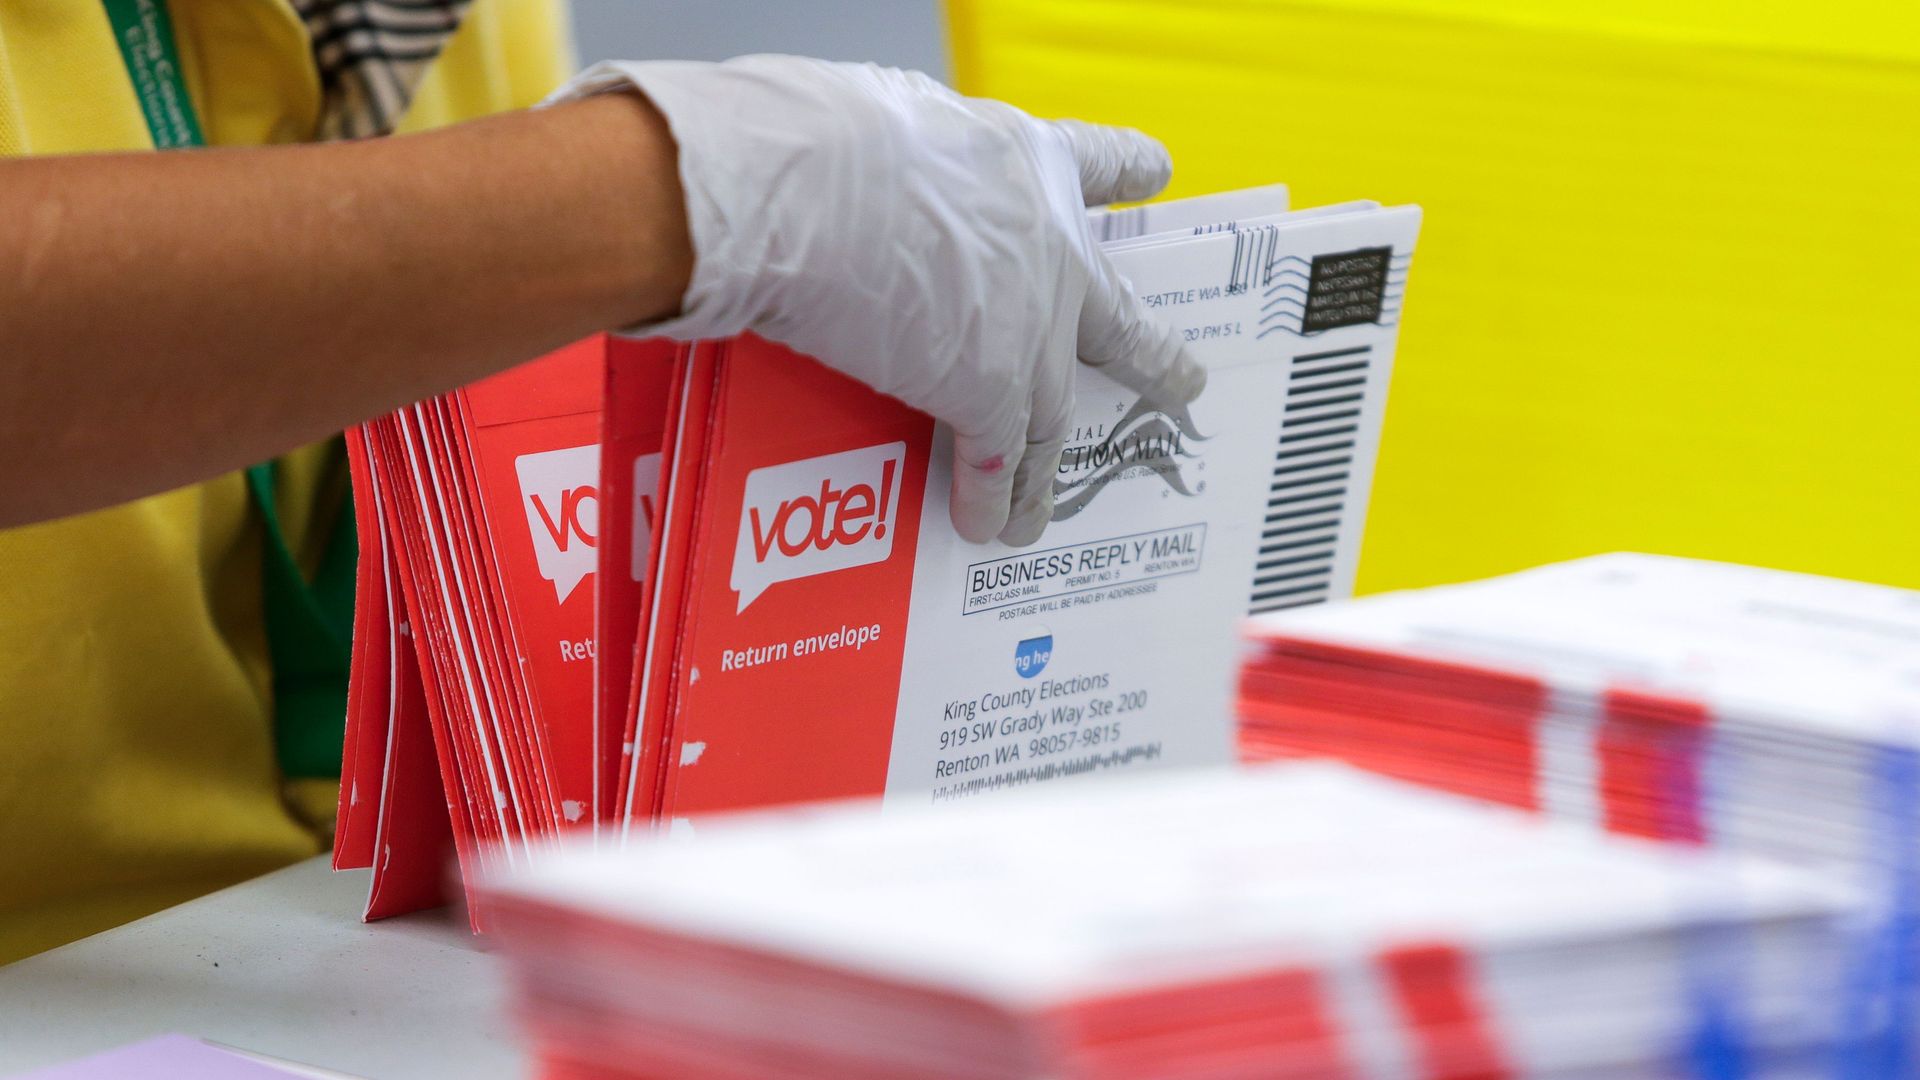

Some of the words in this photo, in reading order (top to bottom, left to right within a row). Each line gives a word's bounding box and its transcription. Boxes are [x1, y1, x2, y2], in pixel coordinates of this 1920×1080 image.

[1141, 289, 1196, 308] EATTLE
[1199, 286, 1220, 300] WA
[1202, 325, 1221, 340] PM
[1223, 323, 1233, 336] 5
[1132, 431, 1184, 462] MAIL
[750, 458, 897, 563] vote!
[970, 588, 1020, 607] FIRST-CLASS
[1022, 584, 1040, 596] MAIL
[1065, 573, 1096, 588] PERMIT
[1099, 571, 1113, 582] NO.
[1115, 569, 1121, 579] 5
[1144, 560, 1179, 573] RENTON
[972, 552, 1073, 593] BUSINESS
[1078, 540, 1148, 572] REPLY
[1151, 531, 1197, 559] MAIL
[999, 604, 1038, 621] POSTAGE
[1040, 600, 1058, 612] WILL
[1061, 598, 1072, 608] BE
[1074, 594, 1093, 606] PAID
[1095, 592, 1105, 603] BY
[1107, 583, 1158, 600] ADDRESSEE
[560, 637, 598, 662] Ret
[721, 642, 787, 672] Return
[793, 623, 881, 656] envelope
[940, 727, 968, 750] 919
[971, 720, 997, 743] SW
[1000, 710, 1047, 736] Grady
[1051, 703, 1085, 726] Way
[1088, 698, 1113, 719] Ste
[1117, 690, 1148, 713] 200
[943, 701, 977, 721] King
[981, 687, 1036, 712] County
[1040, 672, 1110, 700] Elections
[935, 753, 990, 779] Renton
[995, 744, 1020, 766] WA
[1029, 722, 1121, 758] 98057-9815
